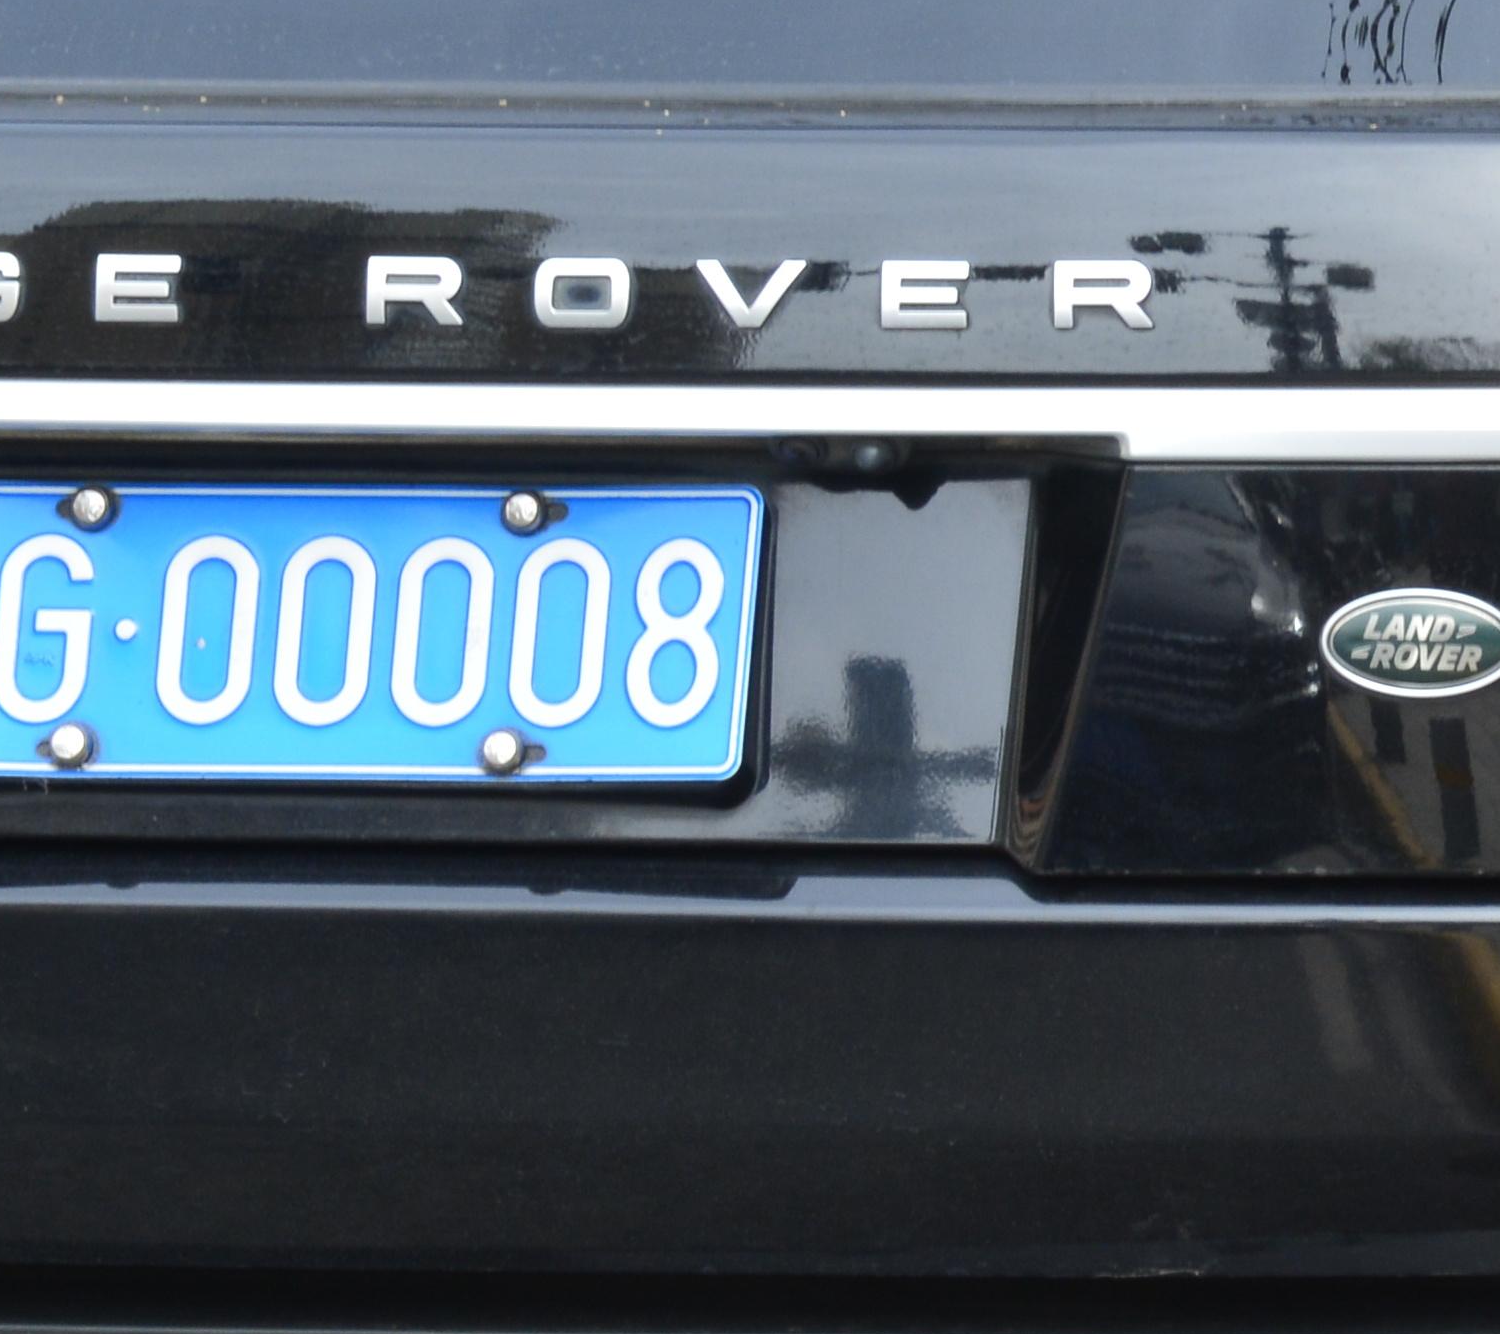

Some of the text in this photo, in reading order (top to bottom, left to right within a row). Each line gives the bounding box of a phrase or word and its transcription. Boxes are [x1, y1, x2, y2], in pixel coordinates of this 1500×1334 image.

[365, 254, 1156, 331] ROVER
[1362, 611, 1457, 642] LAND
[1368, 641, 1484, 672] ROVER
